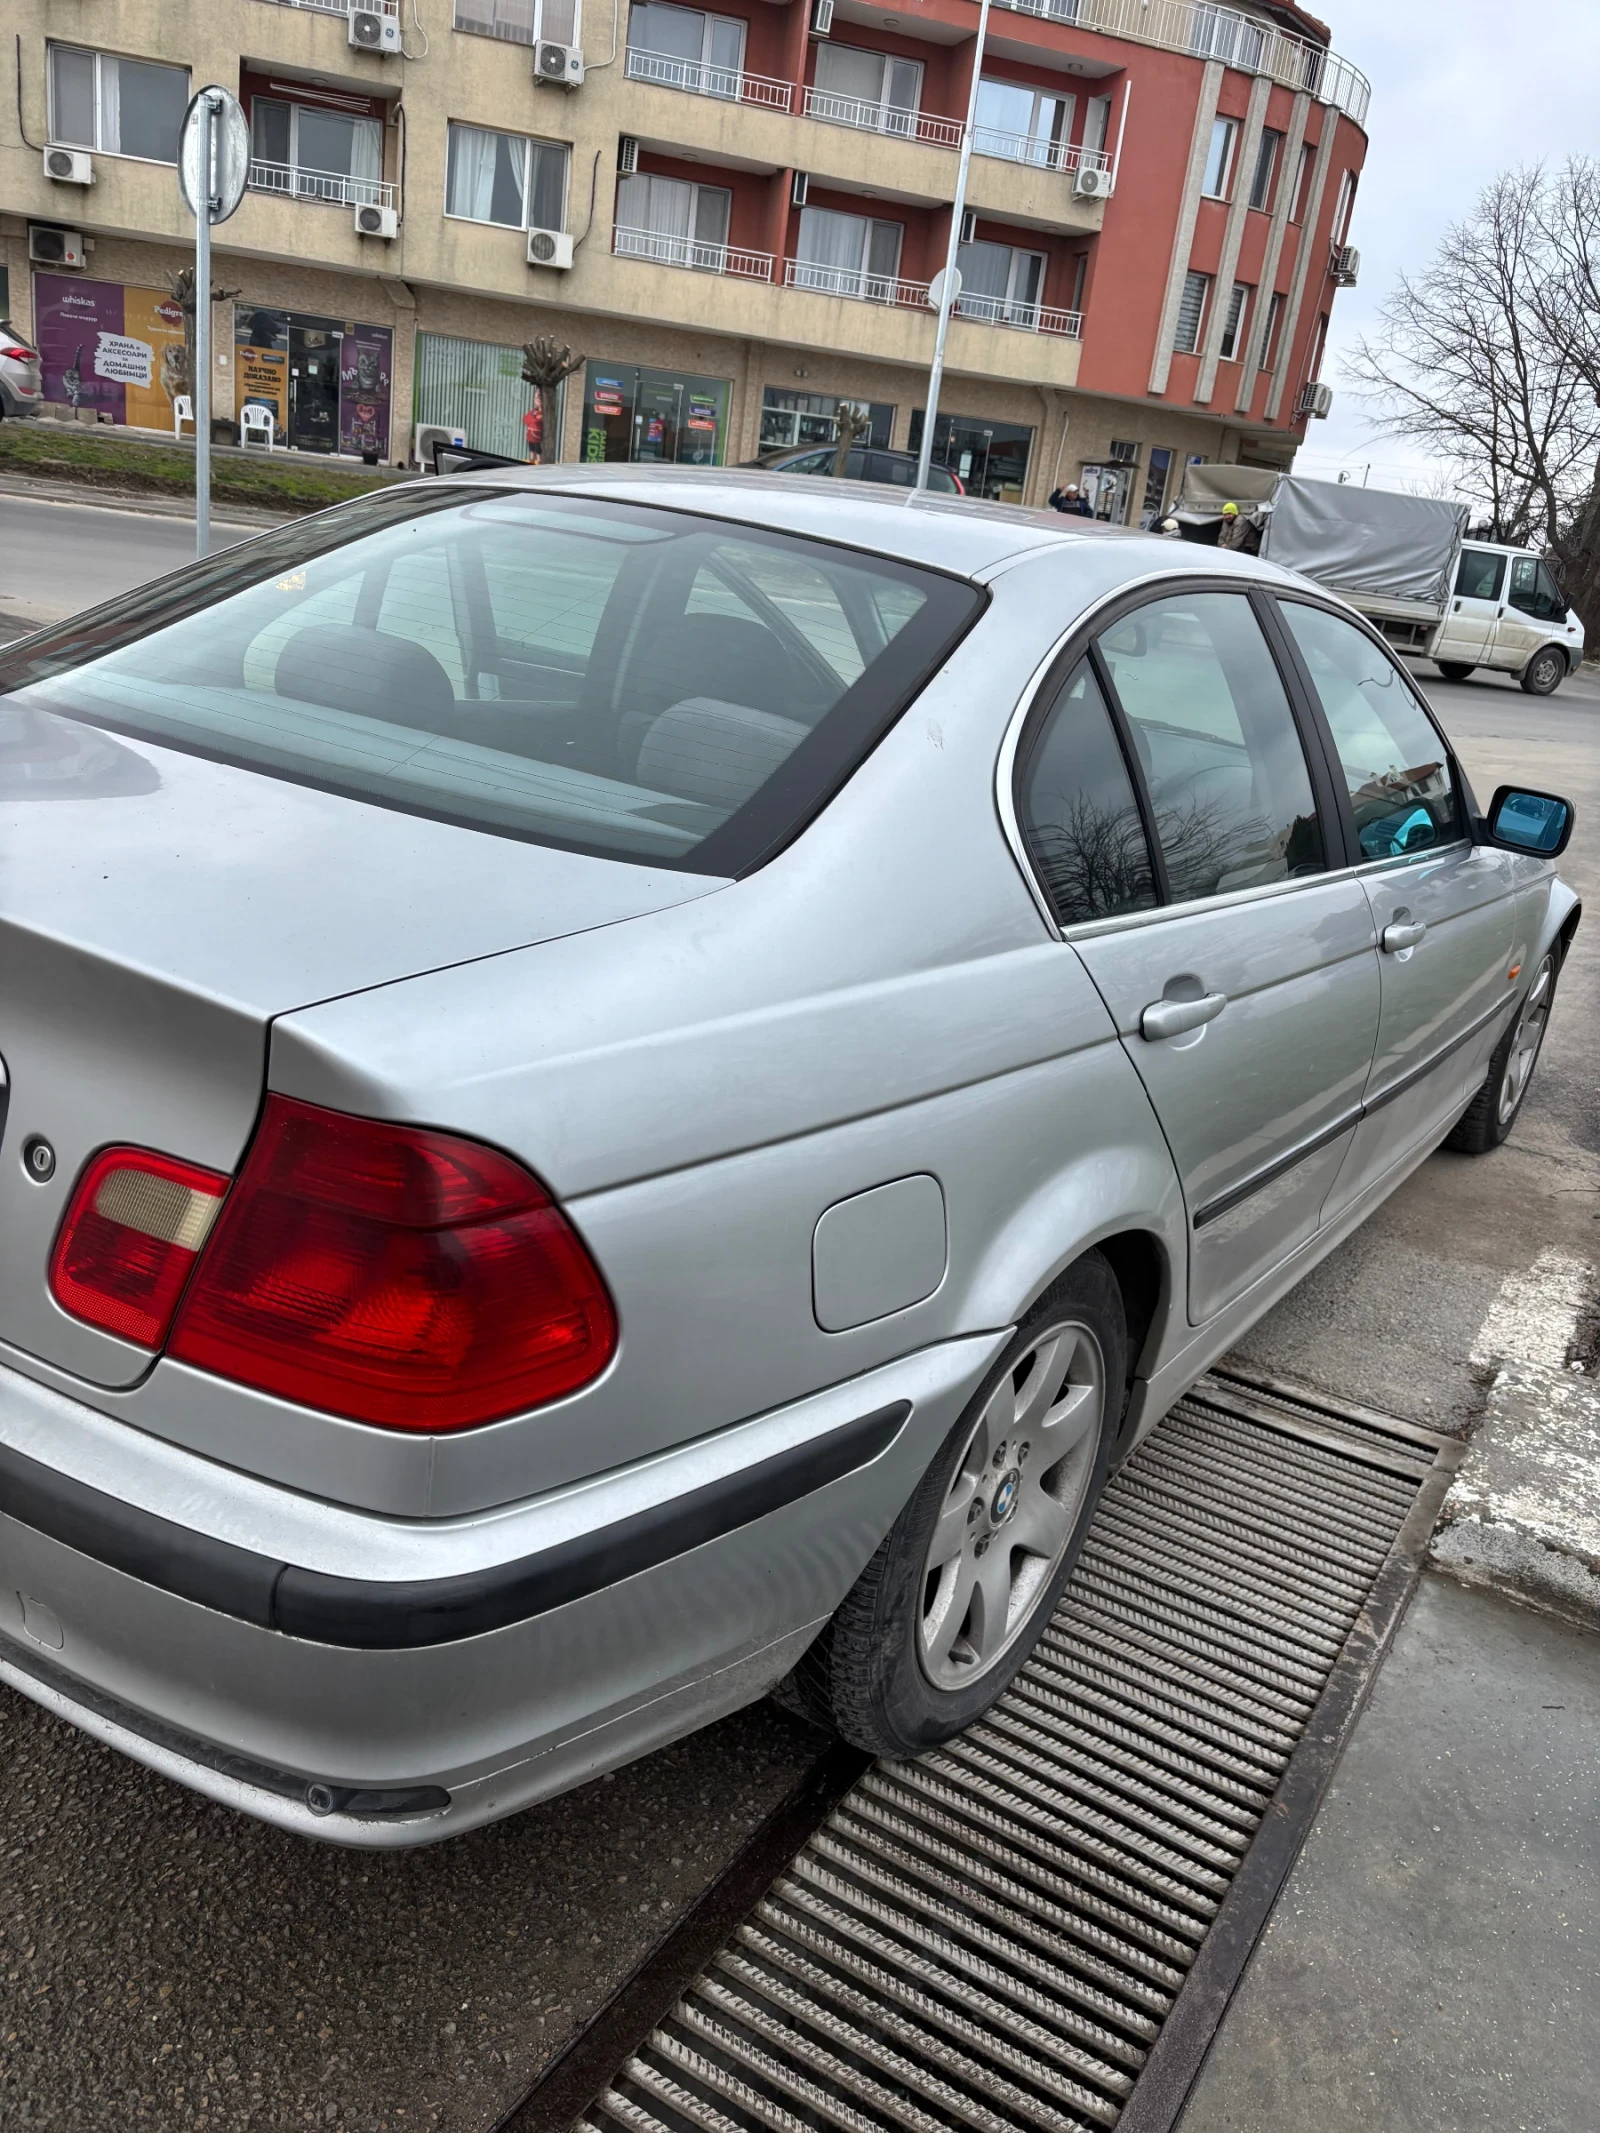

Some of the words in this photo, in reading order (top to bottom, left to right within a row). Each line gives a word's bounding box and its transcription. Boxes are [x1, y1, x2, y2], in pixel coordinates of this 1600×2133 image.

[62, 295, 96, 307] whiskas
[154, 305, 184, 318] Pedigre
[109, 340, 135, 350] ХРАНА
[102, 347, 148, 359] АКСЕСОАРИ
[103, 360, 147, 372] ДОМАШНИ
[105, 367, 148, 379] ЛЮБИМЦИ
